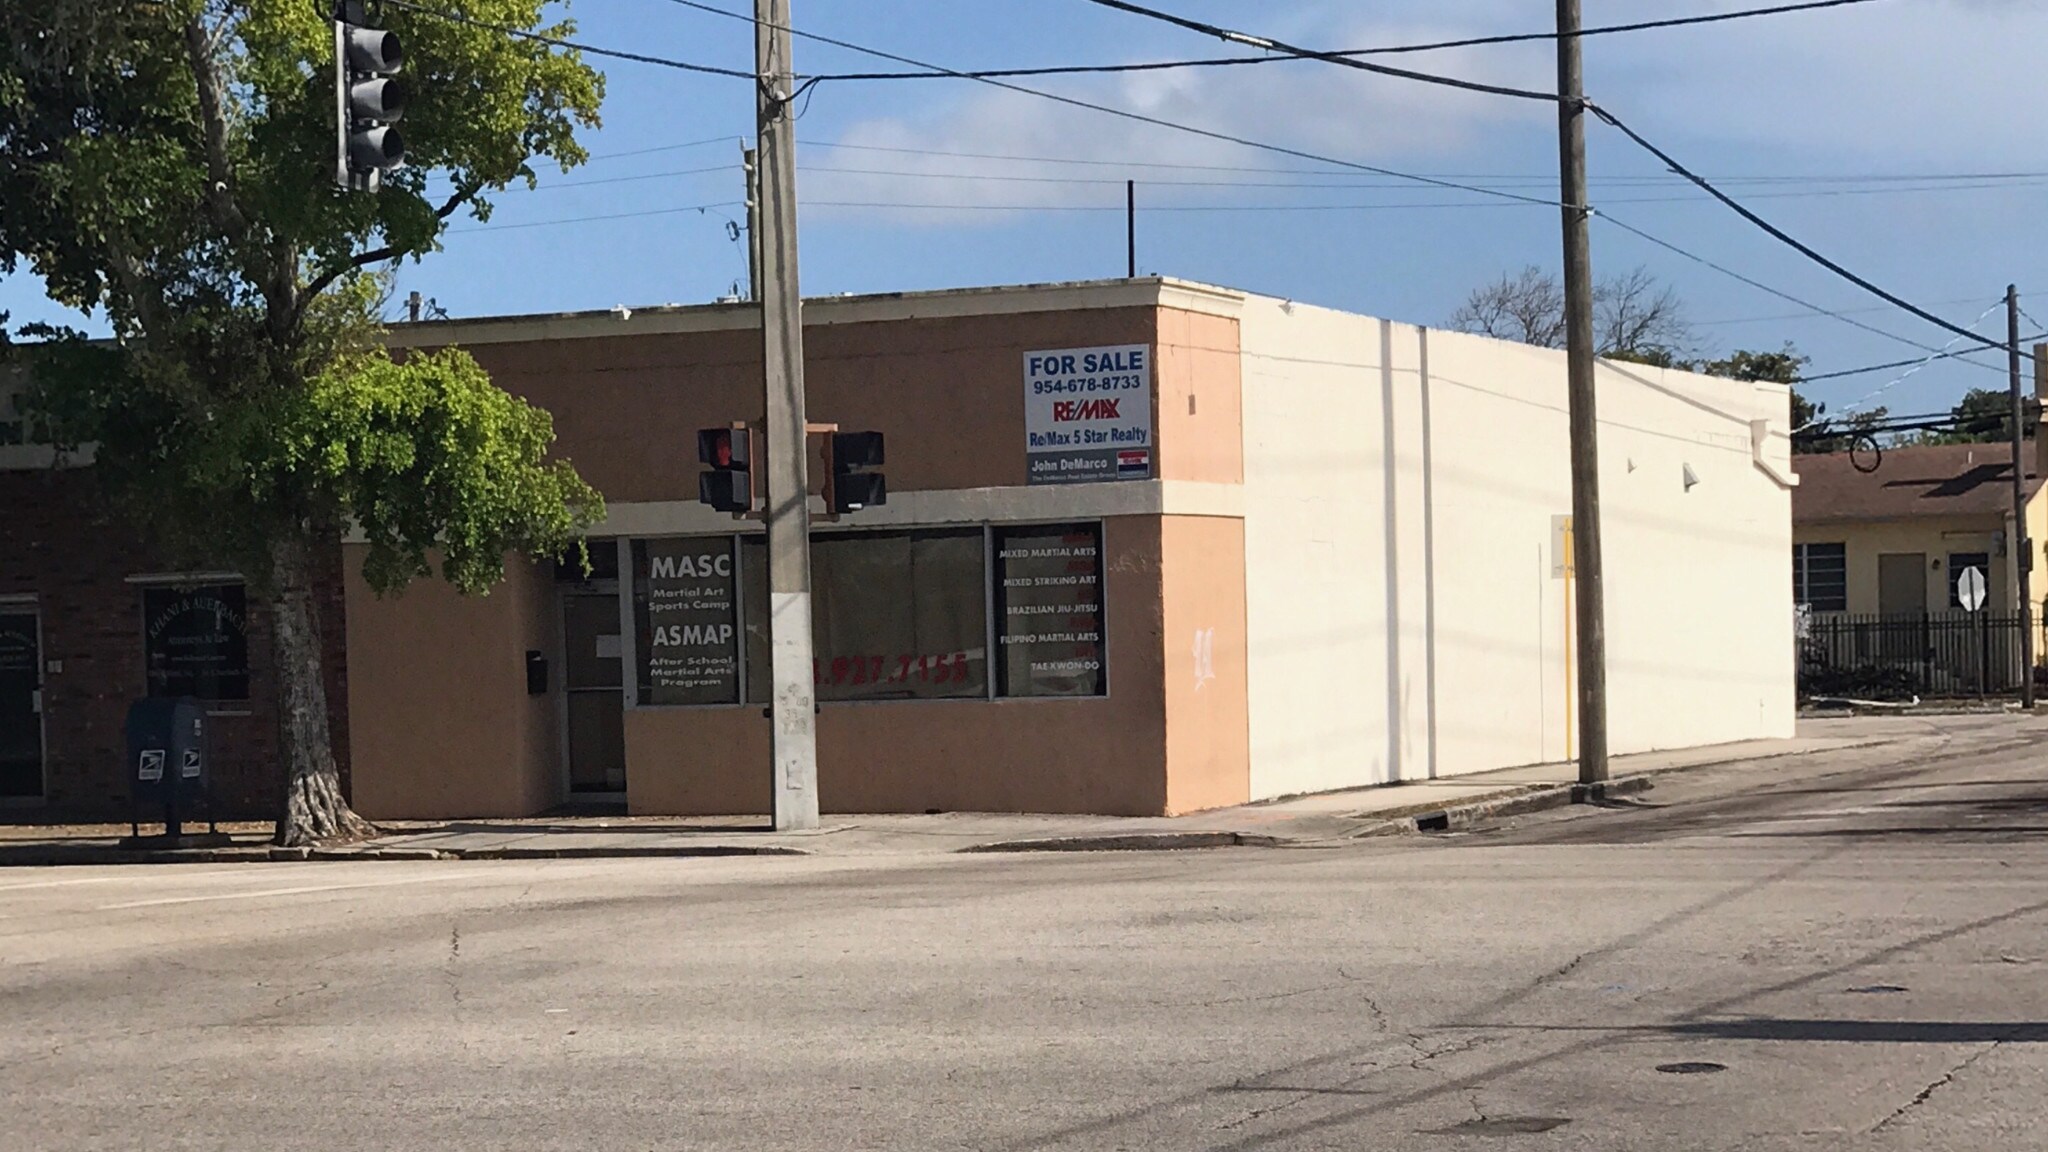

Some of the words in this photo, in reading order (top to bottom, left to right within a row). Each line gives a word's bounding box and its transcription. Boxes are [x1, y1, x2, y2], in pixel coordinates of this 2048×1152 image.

[1030, 355, 1076, 377] FOR
[1083, 351, 1143, 373] SALE
[1034, 375, 1141, 395] 954-678-8733
[1053, 398, 1120, 422] RE/MAX
[1030, 431, 1070, 446] Re/Max
[1074, 430, 1080, 444] 5
[1084, 429, 1108, 443] Star
[1111, 427, 1147, 444] Realty
[1032, 461, 1058, 472] John
[1061, 458, 1108, 471] DeMarco
[1000, 550, 1028, 559] MIXED
[1031, 548, 1071, 557] MARTIAL
[1073, 547, 1096, 556] ARTS
[651, 554, 731, 579] MASC
[1003, 577, 1032, 587] MIXED
[1034, 576, 1077, 586] STRIKING
[1079, 575, 1097, 584] ART
[653, 587, 700, 598] Martial
[704, 587, 725, 597] Art
[648, 601, 690, 613] Sports
[693, 600, 730, 610] Camp
[1007, 605, 1055, 615] BRAZILIAN
[1057, 604, 1098, 613] JIU-JITSU
[653, 624, 733, 647] ASMAP
[1000, 635, 1036, 645] FILIPINO
[1038, 634, 1075, 643] MARTIAL
[1077, 632, 1099, 642] ARTS
[650, 658, 683, 666] After
[687, 656, 733, 665] School
[661, 679, 721, 688] Program
